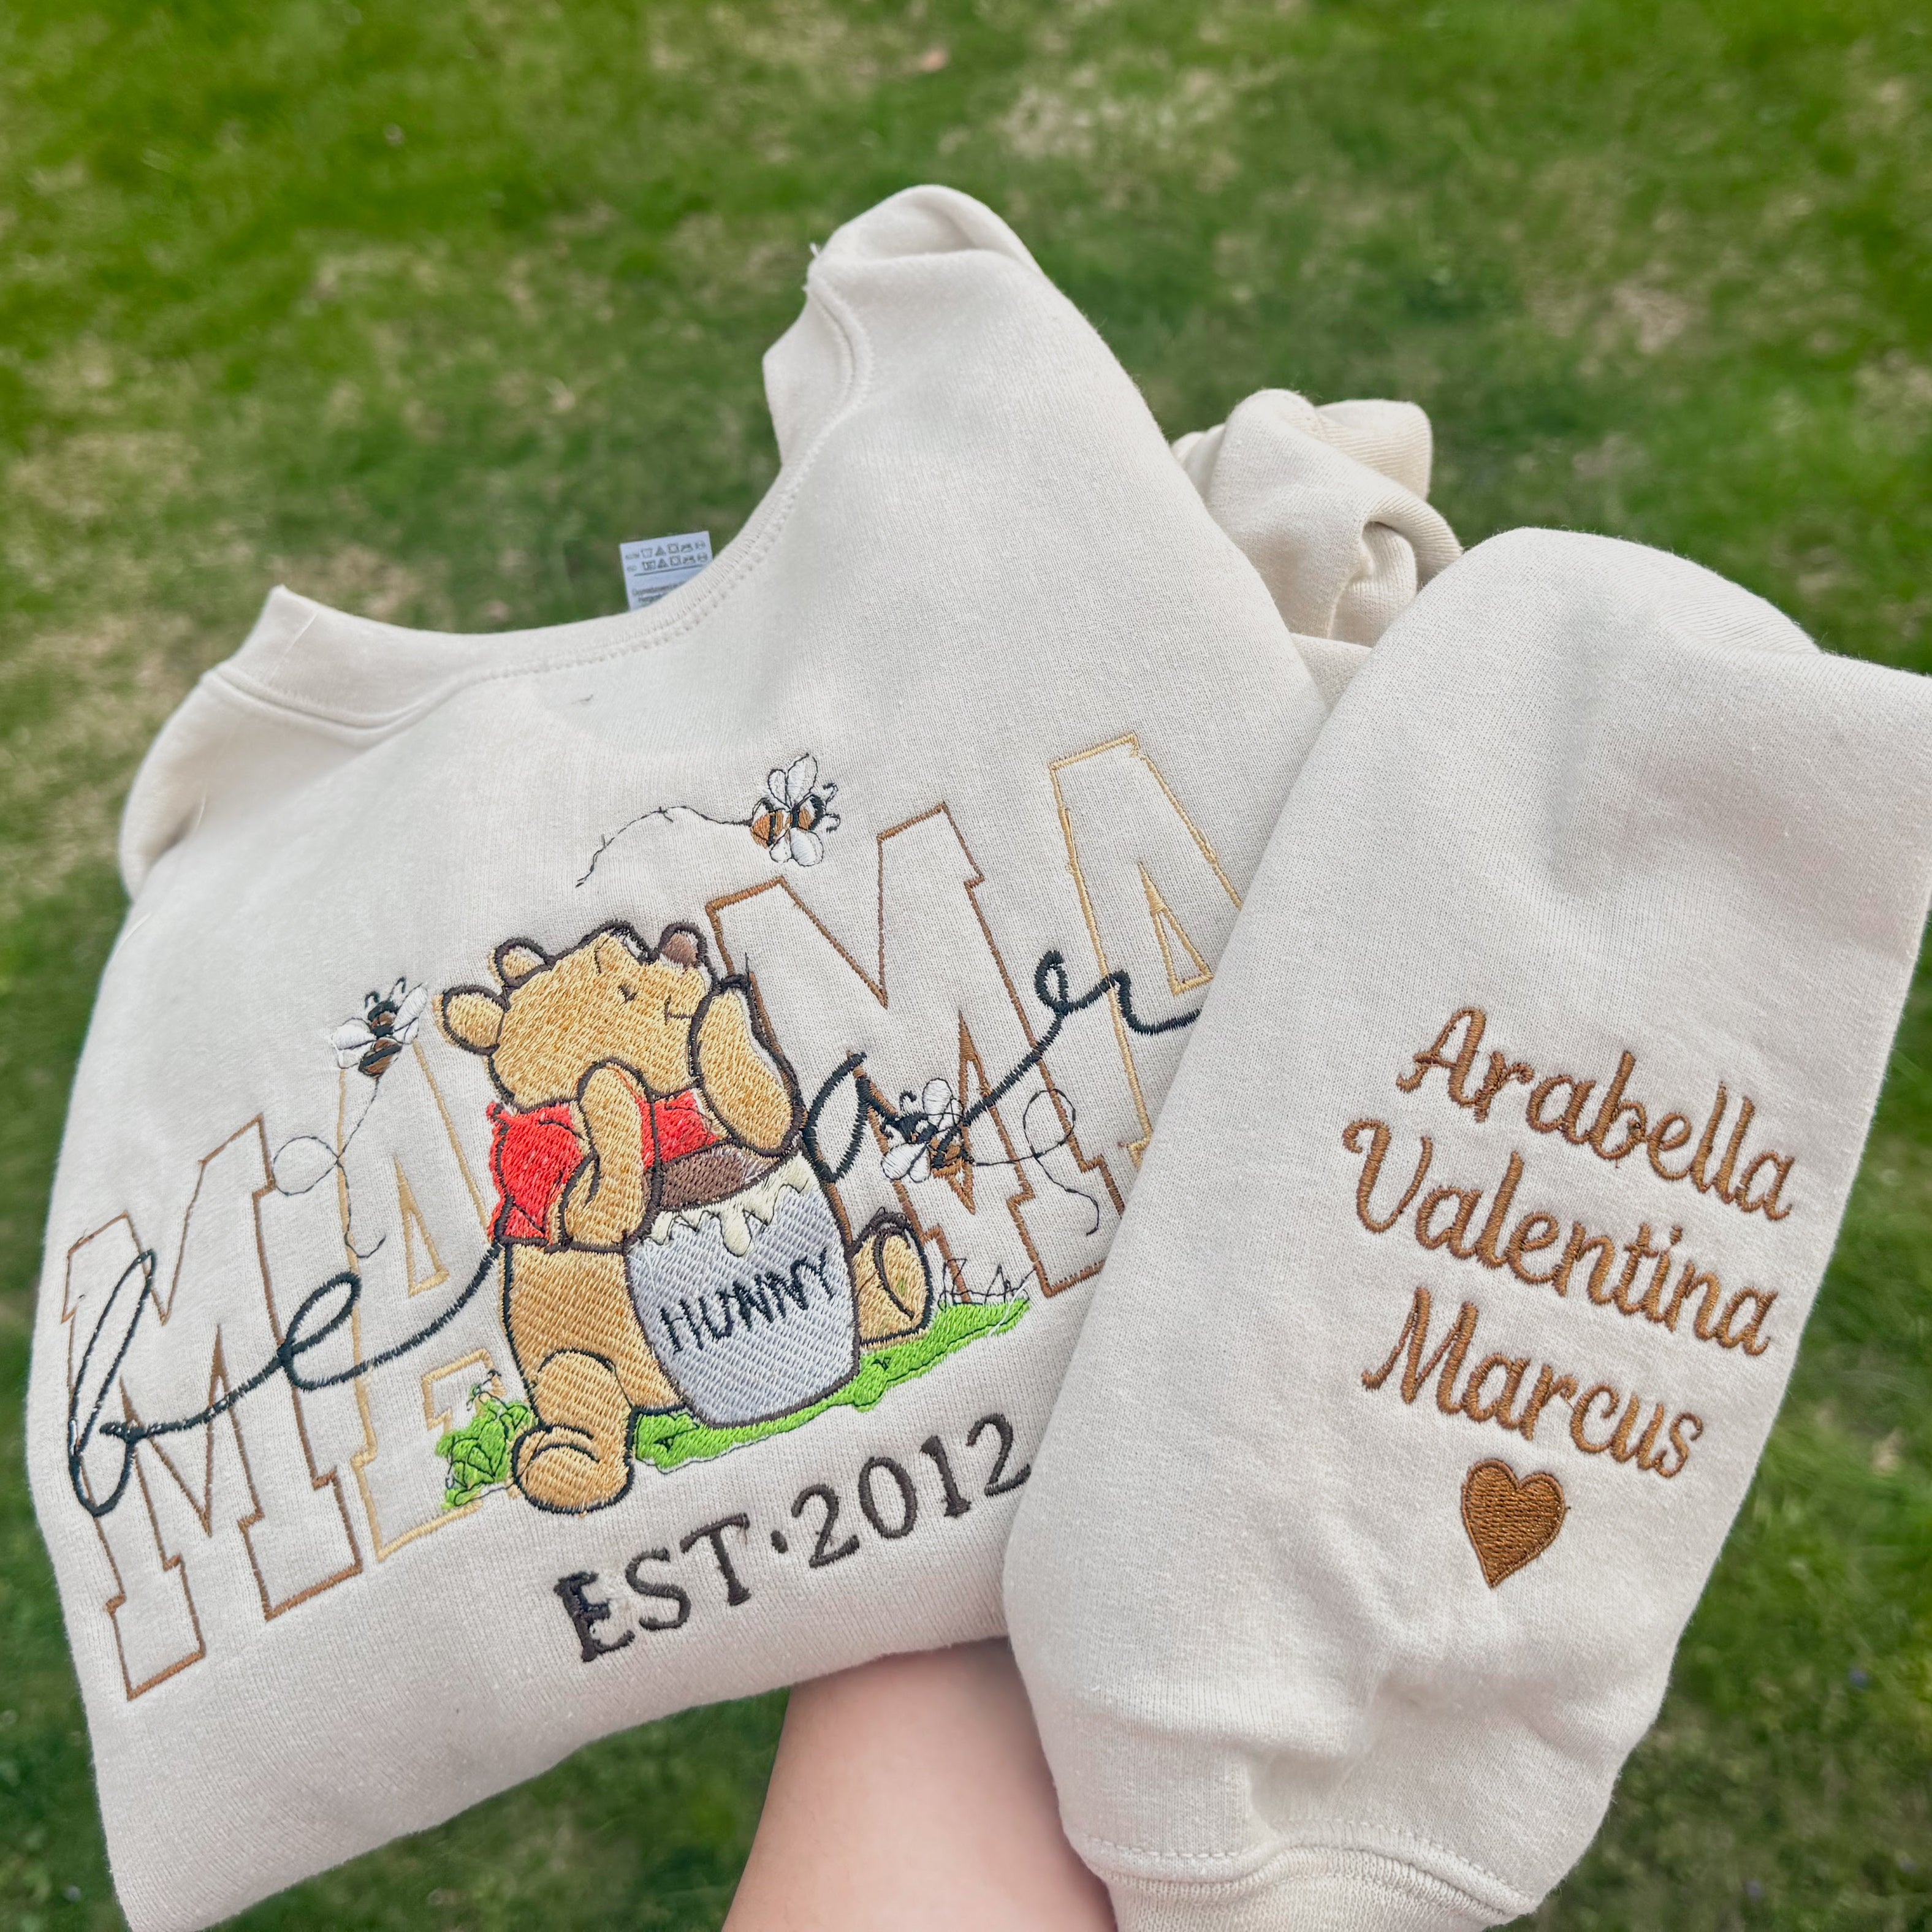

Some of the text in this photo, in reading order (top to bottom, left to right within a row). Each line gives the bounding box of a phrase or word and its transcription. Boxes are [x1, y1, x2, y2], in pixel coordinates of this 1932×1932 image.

[1396, 1006, 1795, 1221] Arabella
[660, 1248, 834, 1355] HUNNY
[1342, 1119, 1779, 1356] Valentina
[1361, 1287, 1703, 1479] Marcus
